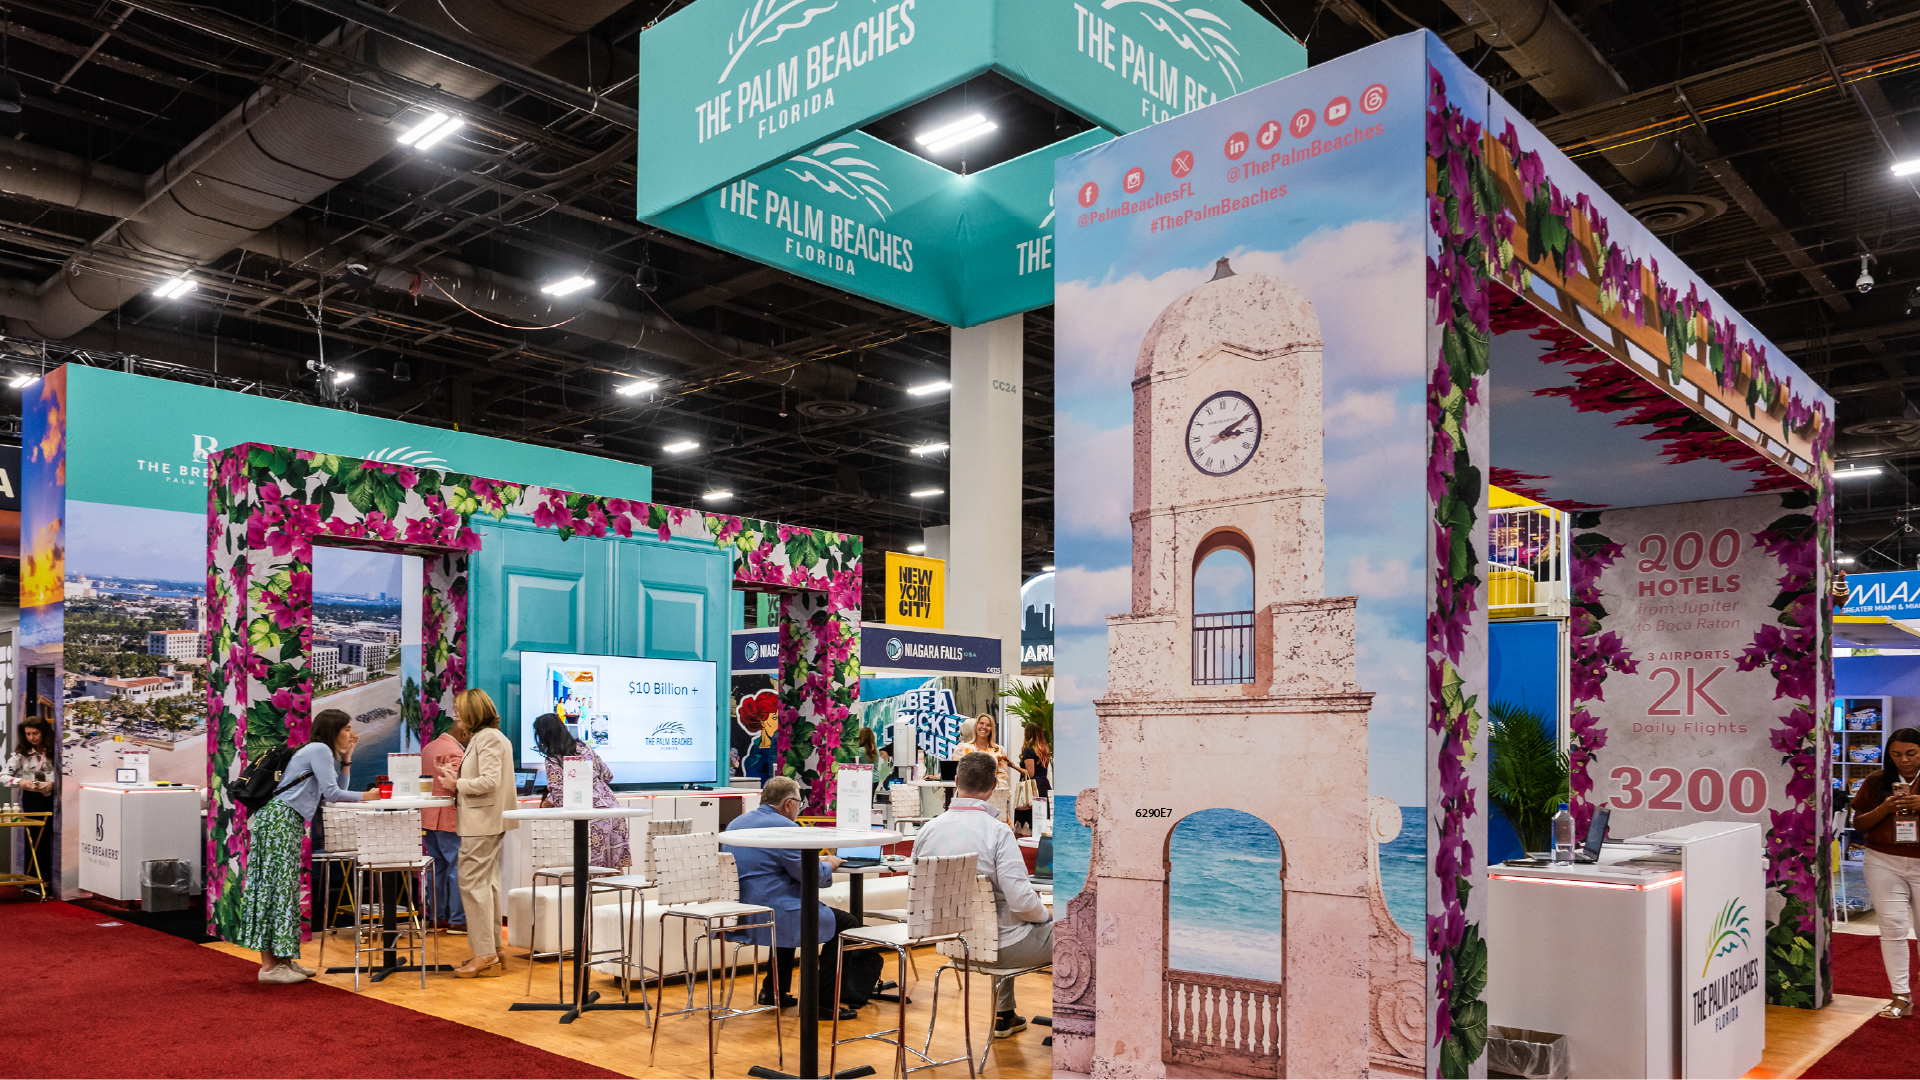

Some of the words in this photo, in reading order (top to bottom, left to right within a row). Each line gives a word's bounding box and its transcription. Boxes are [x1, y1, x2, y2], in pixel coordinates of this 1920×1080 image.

[1074, 2, 1116, 71] THE
[1122, 34, 1178, 109] PALM
[695, 89, 731, 144] THE
[738, 55, 798, 124] PALM
[807, 0, 915, 91] BEACHES
[758, 88, 835, 139] FLORIDA
[1227, 123, 1384, 183] @ThePalmBeaches
[1078, 182, 1195, 228] @PalmBeachesFL
[1150, 184, 1288, 235] #ThePalmBeaches
[765, 189, 823, 243] PALM
[830, 214, 913, 272] BEACHES
[786, 237, 855, 275] FLORIDA
[1016, 234, 1053, 276] THE
[992, 379, 1017, 395] CC24
[137, 460, 170, 474] THE
[166, 477, 195, 485] PALM
[1637, 528, 1741, 573] 200
[899, 566, 933, 585] NEW
[1638, 574, 1741, 597] HOTELS
[900, 583, 931, 602] YORK
[1844, 581, 1920, 606] MIA
[899, 600, 931, 619] CITY
[1638, 602, 1674, 617] from
[1679, 600, 1739, 617] Jupiter
[1842, 605, 1873, 614] GREATER
[1638, 621, 1651, 632] to
[1656, 619, 1691, 632] Boca
[1697, 618, 1740, 630] Raton
[904, 643, 939, 659] NIAGARA
[940, 645, 963, 660] FALLS
[1647, 652, 1655, 662] 3
[1659, 650, 1730, 661] AIRPORTS
[629, 680, 651, 695] $10
[654, 682, 688, 696] Billion
[691, 686, 698, 694] +
[1647, 665, 1731, 716] 2K
[908, 692, 930, 711] BE
[936, 693, 950, 715] A
[1633, 722, 1676, 736] Daily
[1684, 722, 1748, 736] Flights
[645, 737, 655, 745] THE
[656, 737, 670, 745] PALM
[671, 737, 693, 745] BEACHES
[1609, 766, 1768, 815] 3200
[81, 843, 91, 854] THE
[92, 845, 119, 860] BREAKERS
[1693, 987, 1707, 1026] THE
[1708, 974, 1728, 1017] PALM
[1730, 958, 1759, 1003] BEACHES
[1715, 1005, 1739, 1033] FLORIDA
